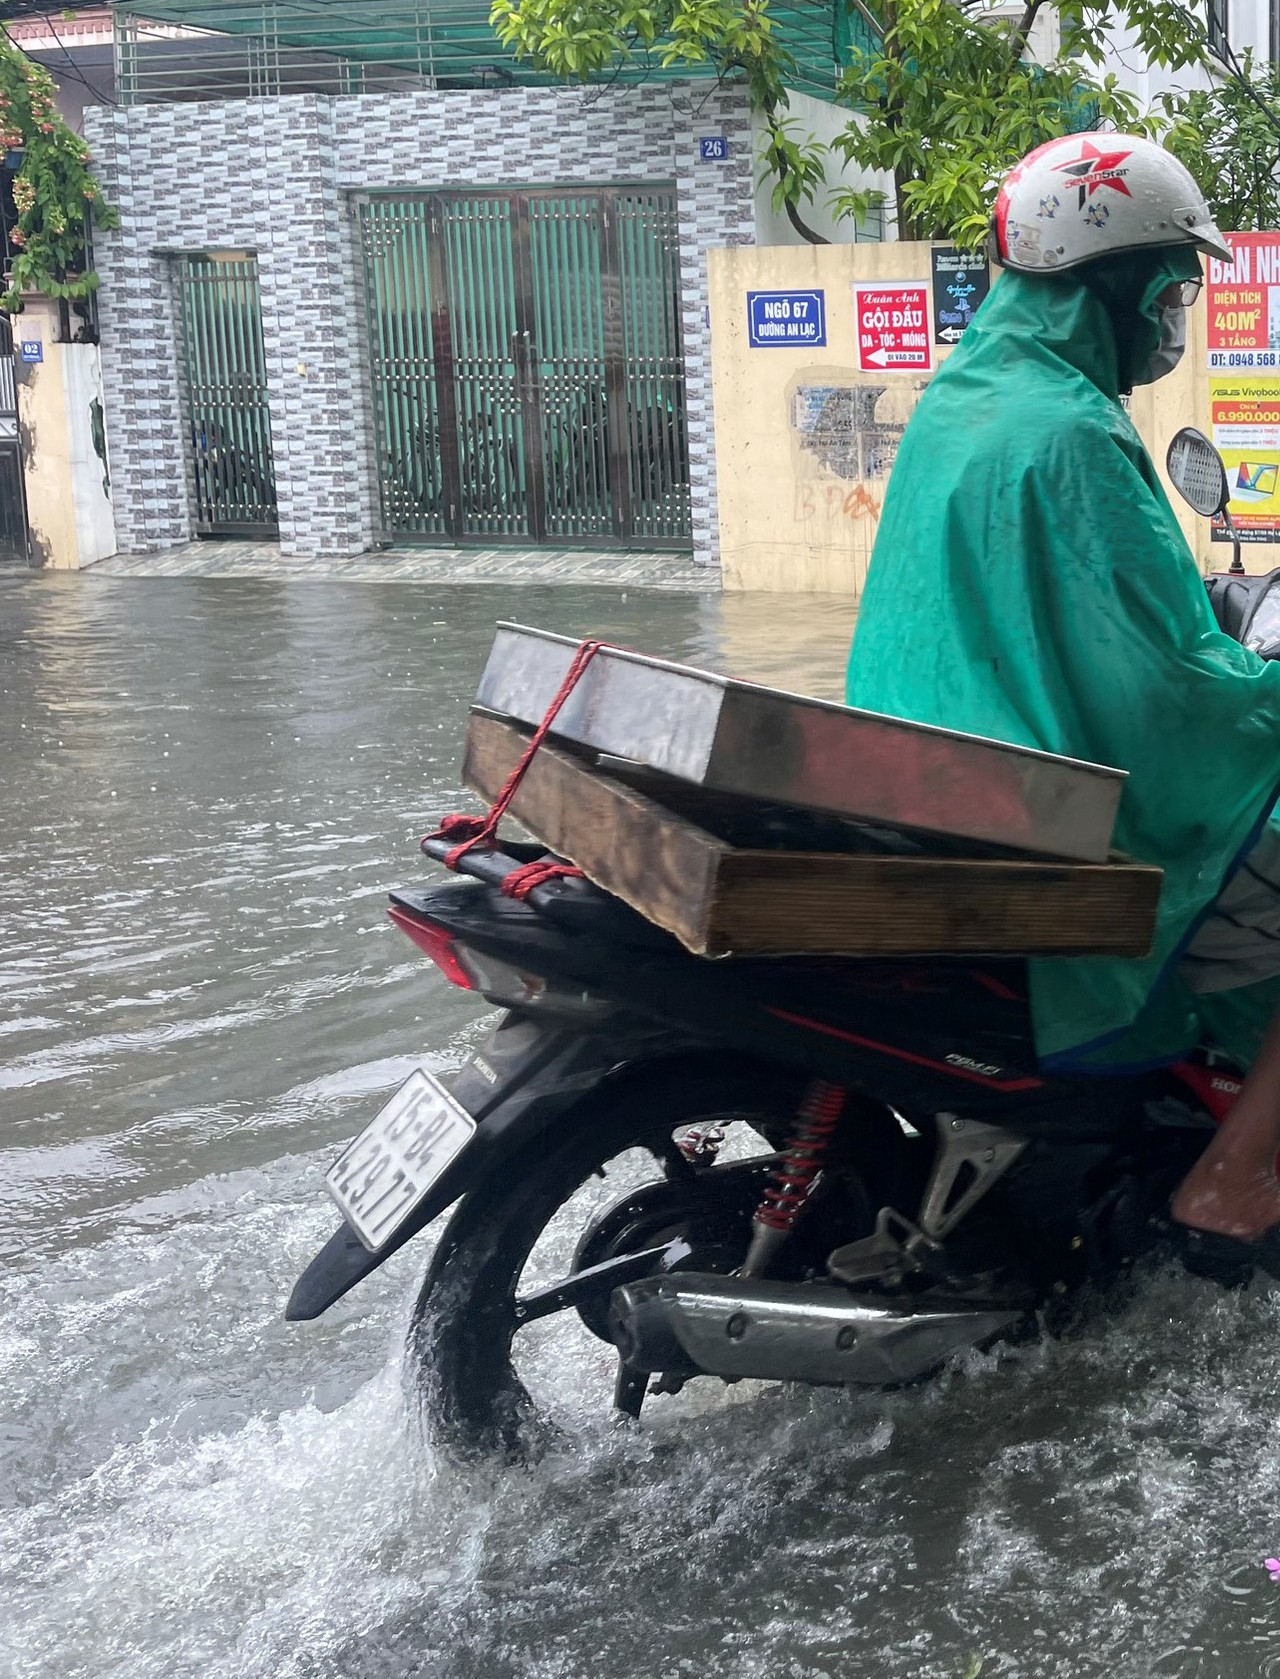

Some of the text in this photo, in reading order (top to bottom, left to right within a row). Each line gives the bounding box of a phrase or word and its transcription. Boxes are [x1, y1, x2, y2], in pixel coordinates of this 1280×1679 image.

[705, 140, 722, 157] 26
[1064, 168, 1130, 189] SevenStar
[863, 293, 893, 304] Xuân
[1214, 290, 1261, 306] DIỆN TÍCH
[764, 299, 809, 319] NGÕ 67
[862, 306, 890, 332] GỘI
[758, 321, 816, 338] ĐƯỜNG AN LẠC
[862, 334, 873, 348] DA
[879, 331, 895, 347] TÓC
[901, 330, 926, 347] MÓNG
[1219, 337, 1226, 346] 3
[24, 344, 38, 354] 02
[1211, 353, 1226, 366] ĐT:
[1228, 353, 1254, 366] 0948
[1257, 353, 1276, 366] 568
[1212, 388, 1241, 396] ASUS
[1217, 411, 1280, 423] 6.990.000
[473, 1056, 498, 1085] HONDA
[333, 1132, 417, 1234] 429.77
